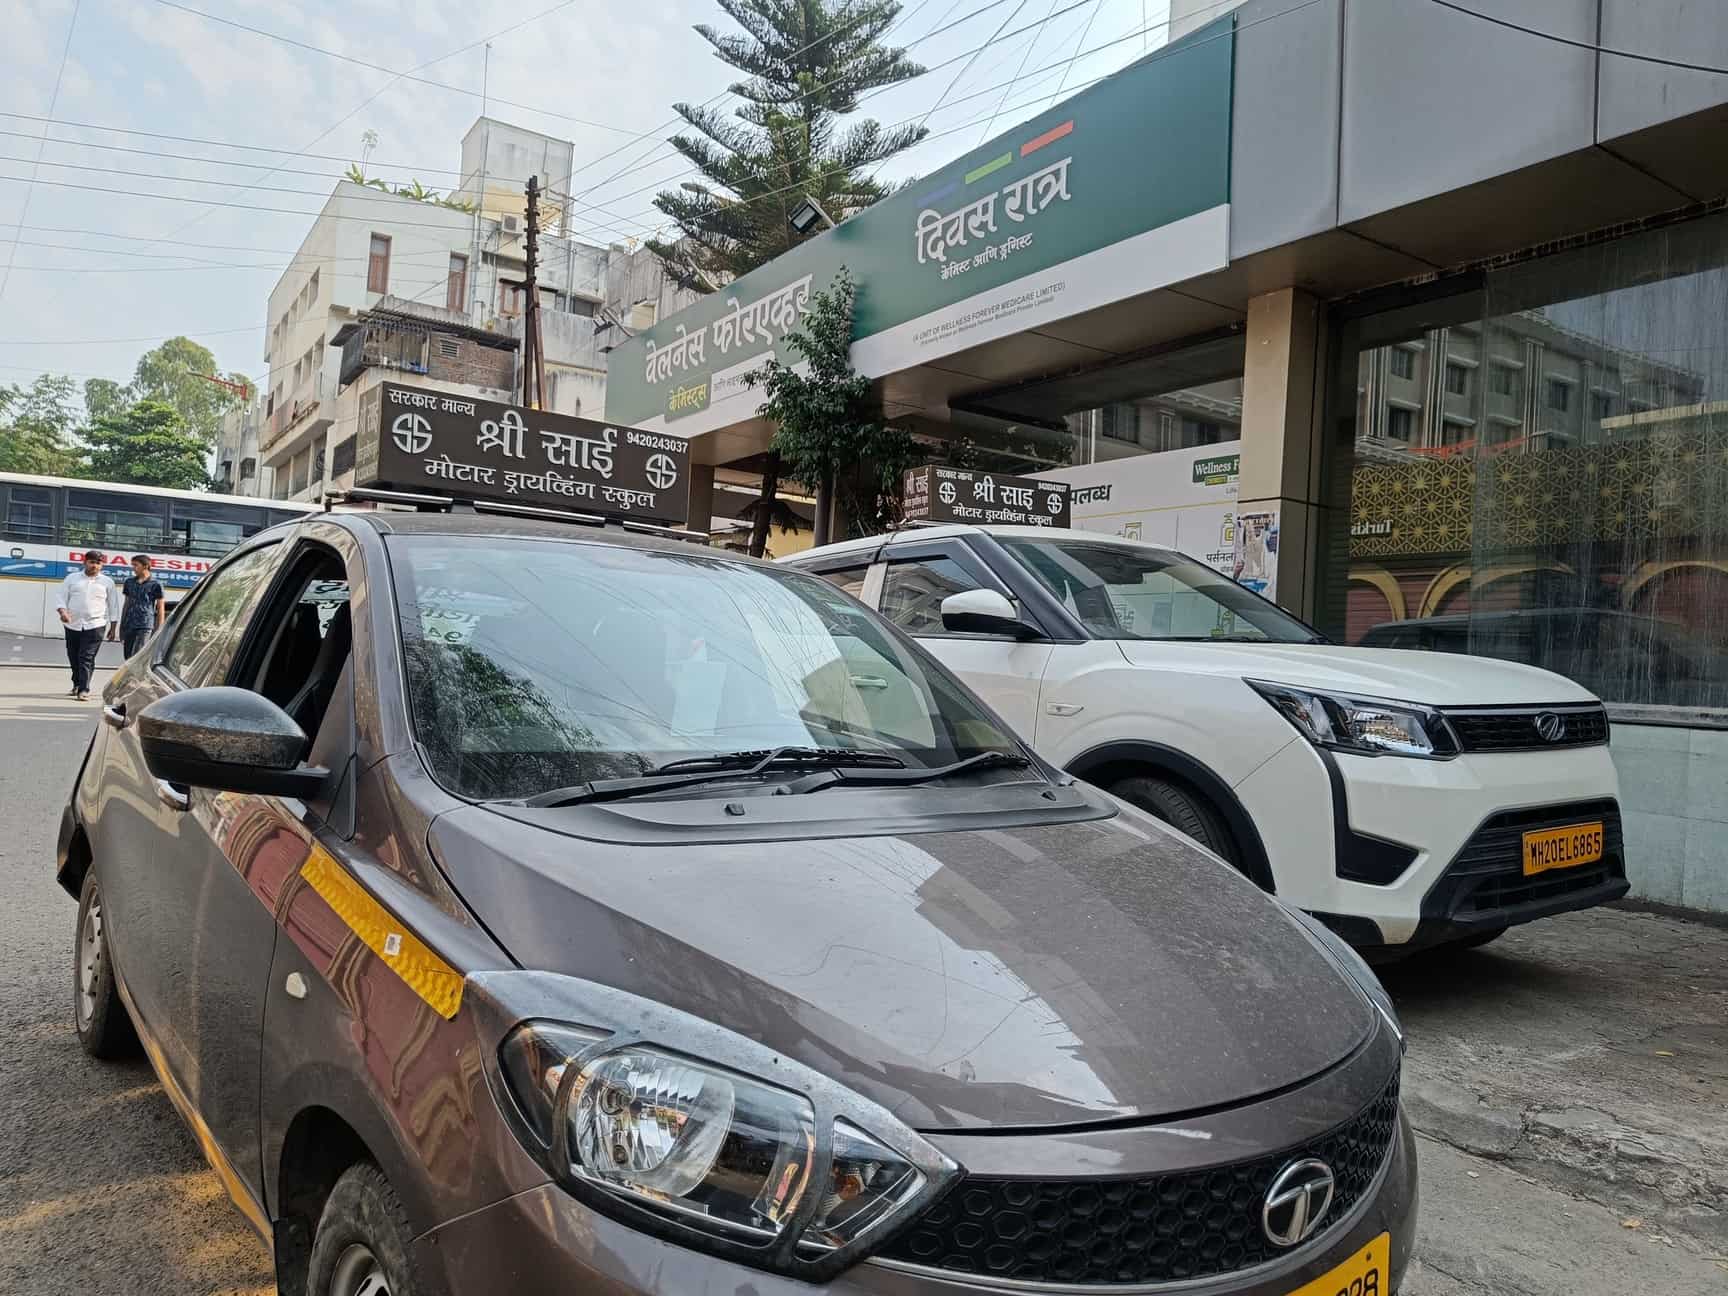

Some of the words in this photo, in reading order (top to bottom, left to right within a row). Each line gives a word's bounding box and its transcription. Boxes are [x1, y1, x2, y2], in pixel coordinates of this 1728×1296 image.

[915, 192, 999, 264] दिवस
[1003, 157, 1072, 222] रात्र
[941, 259, 972, 280] केमिस्ट
[973, 245, 998, 268] आणि
[940, 314, 971, 332] WELLNESS
[971, 304, 1000, 322] FOREVER
[1000, 292, 1034, 311] MEDICARE
[646, 324, 707, 384] वेलनेस
[388, 389, 438, 410] सरकार
[441, 398, 476, 416] मान्य
[476, 410, 529, 459] श्री
[539, 427, 618, 479] साई
[626, 431, 689, 454] 9420243037
[423, 453, 497, 485] मोटार
[503, 470, 596, 499] ड्रायव्हिंग
[1195, 461, 1232, 476] Wellness
[973, 475, 996, 503] श्री
[952, 502, 983, 519] मोटार
[1530, 831, 1601, 867] MH20EL6865
